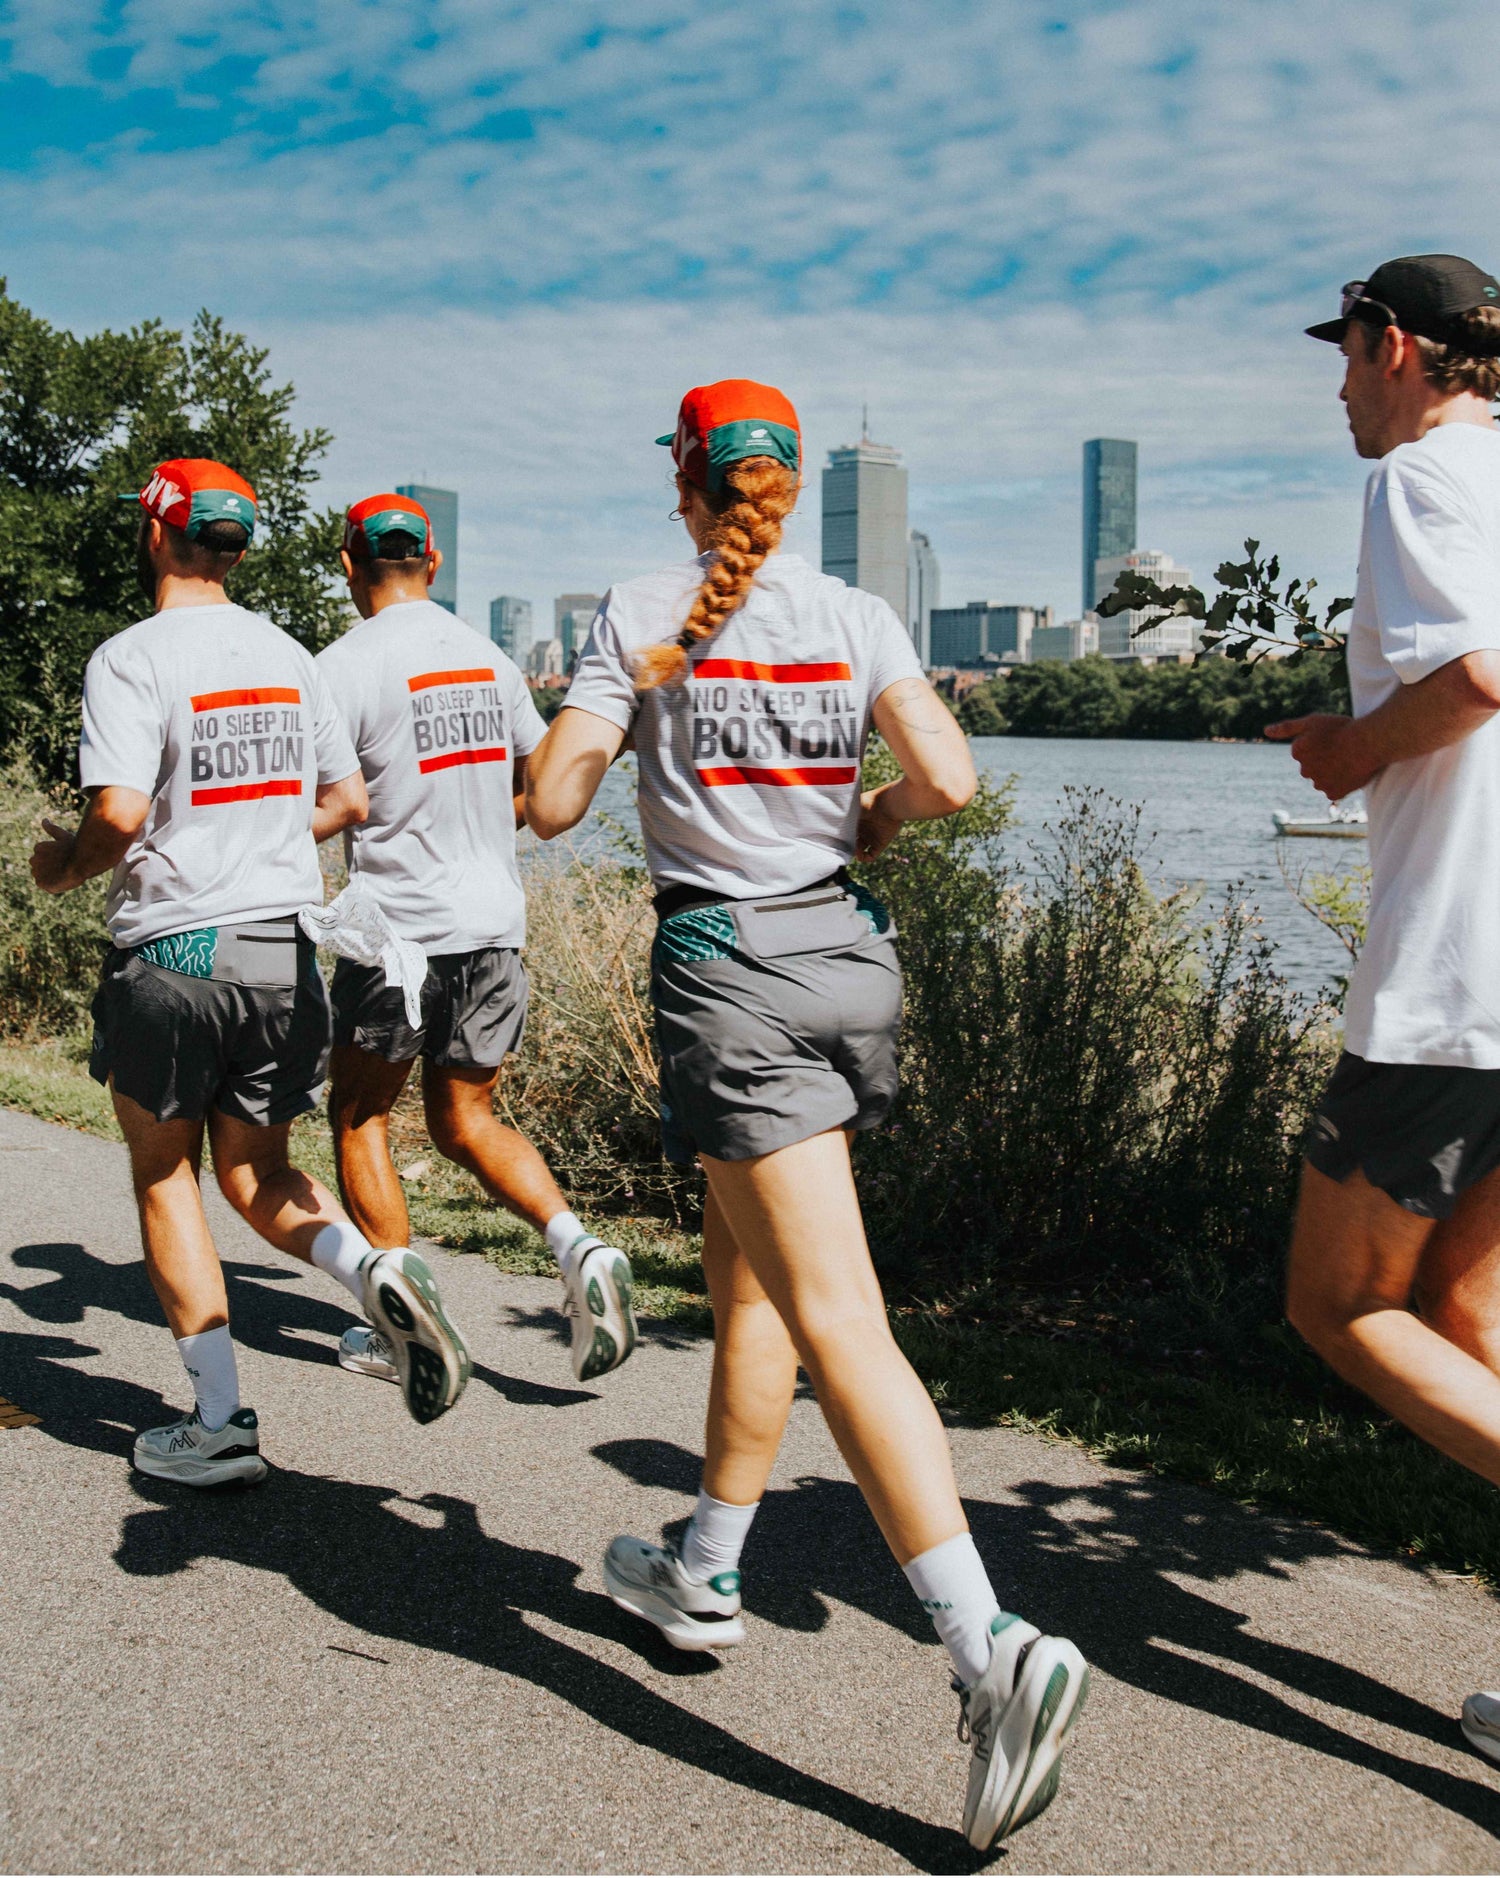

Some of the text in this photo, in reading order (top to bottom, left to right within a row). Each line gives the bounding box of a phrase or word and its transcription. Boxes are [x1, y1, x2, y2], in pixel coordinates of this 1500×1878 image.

[141, 470, 186, 517] NY
[411, 687, 503, 718] NO SLEEP TIL
[693, 686, 856, 715] NO SLEEP TIL
[191, 710, 304, 742] NO SLEEP TIL
[413, 709, 505, 754] BOSTON
[692, 716, 858, 760] BOSTON
[191, 735, 304, 783] BOSTON
